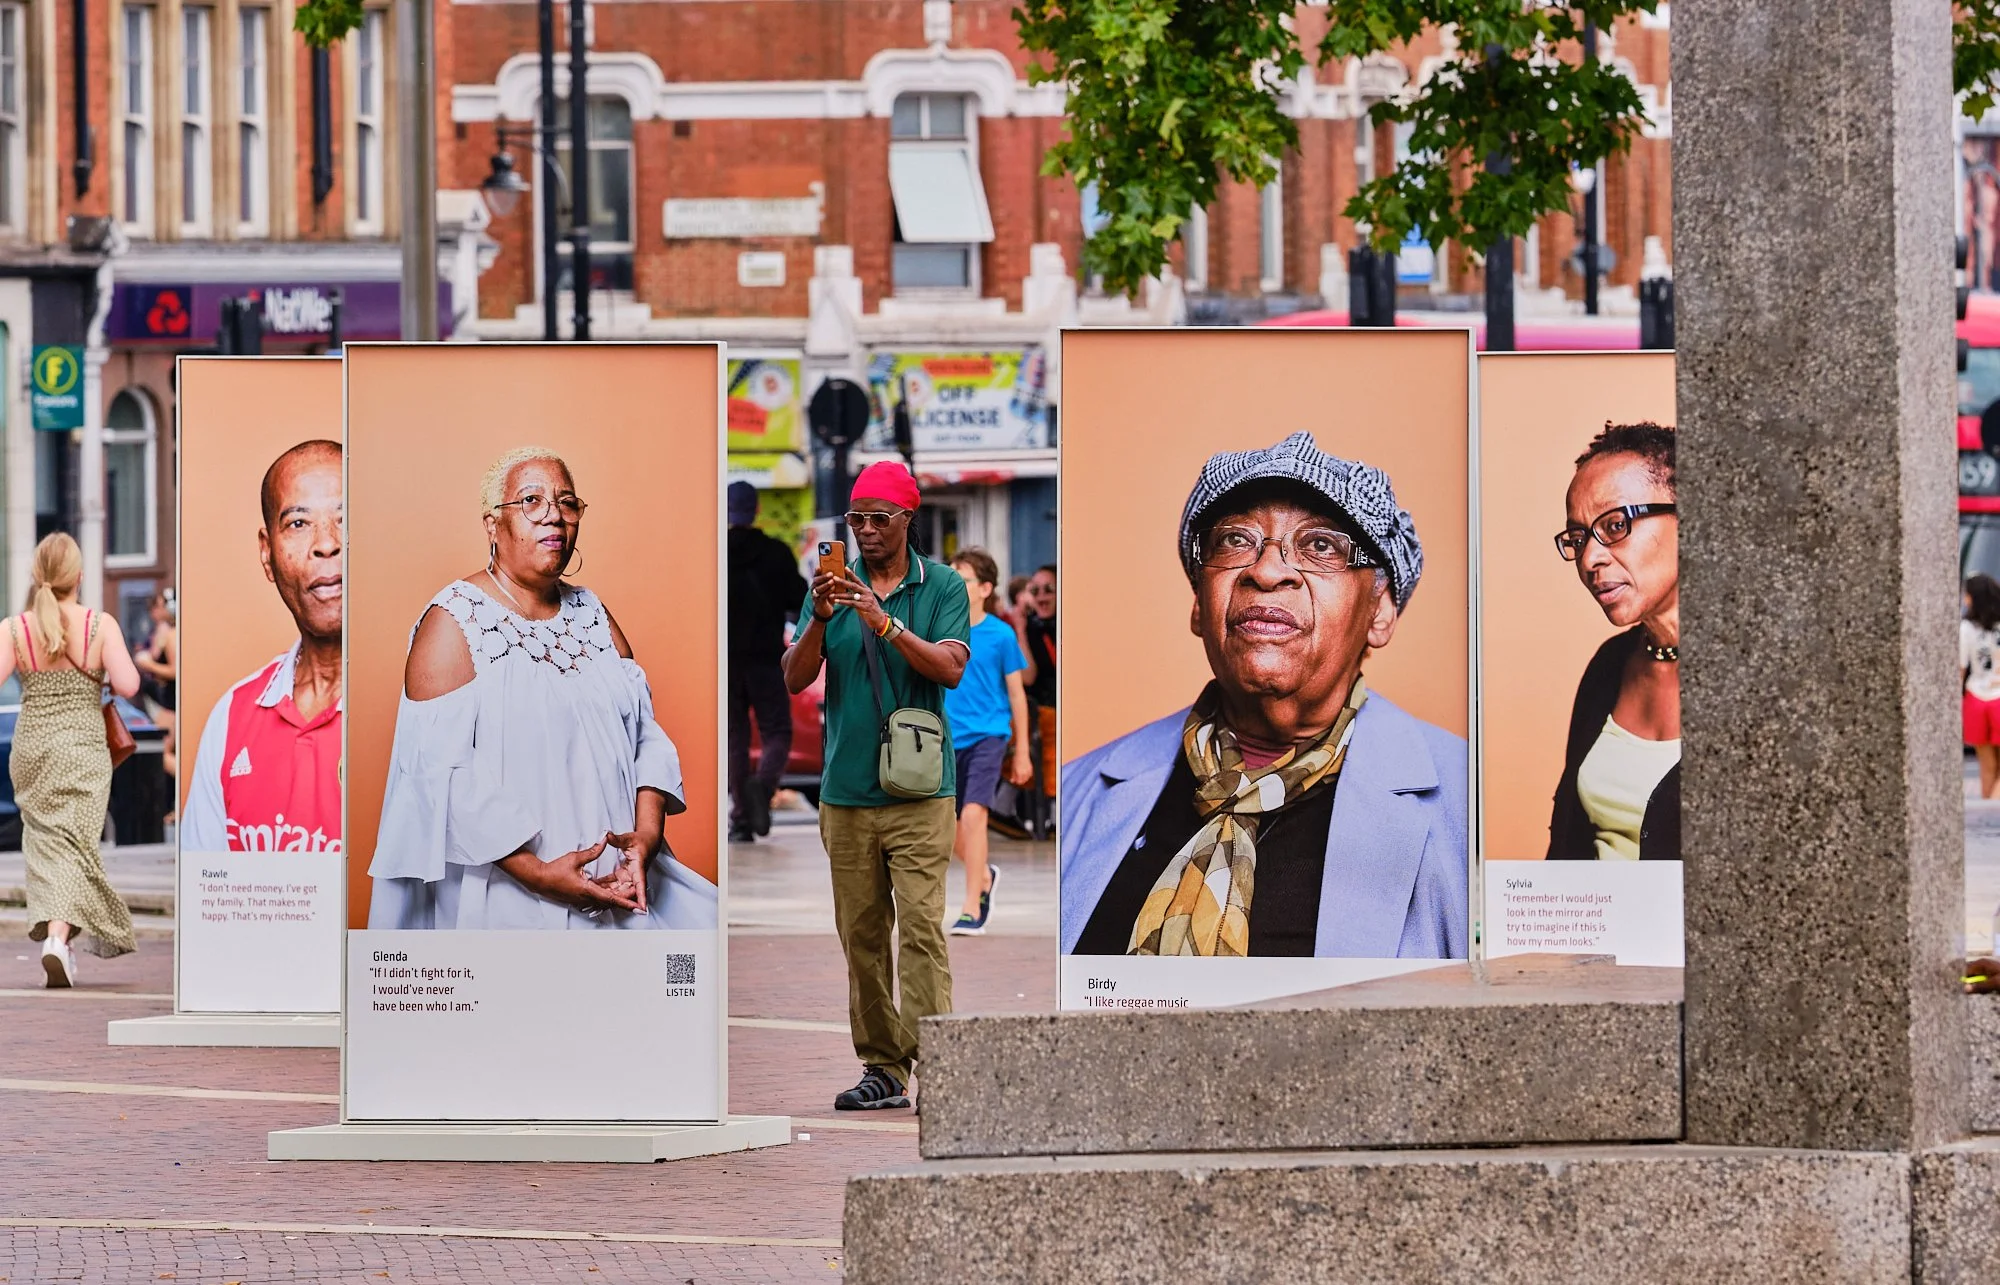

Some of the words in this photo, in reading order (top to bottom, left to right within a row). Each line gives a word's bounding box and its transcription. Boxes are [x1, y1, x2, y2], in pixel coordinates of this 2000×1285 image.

[911, 407, 1001, 429] LICENSE
[202, 870, 227, 878] Rawle
[1506, 879, 1532, 889] Sylvia
[208, 884, 228, 892] don't
[232, 884, 252, 892] need
[254, 886, 284, 894] money.
[287, 884, 301, 893] I've
[303, 885, 317, 895] got
[202, 900, 215, 908] my
[218, 898, 244, 908] family.
[248, 898, 266, 906] That
[269, 899, 295, 907] makes
[1513, 894, 1558, 902] remember
[1566, 894, 1593, 903] would
[1595, 894, 1611, 904] just
[202, 912, 229, 922] happy.
[232, 912, 257, 920] That's
[260, 914, 272, 922] my
[1507, 908, 1525, 917] look
[1528, 908, 1536, 917] in
[1539, 909, 1552, 917] the
[1556, 908, 1583, 917] mirror
[1586, 909, 1602, 917] and
[1507, 924, 1520, 932] try
[1534, 922, 1569, 934] imagine
[1572, 923, 1578, 931] if
[1581, 923, 1596, 931] this
[1599, 922, 1606, 932] is
[1507, 937, 1526, 945] how
[1529, 939, 1542, 947] my
[373, 951, 407, 961] Glenda
[370, 968, 381, 977] "If
[390, 968, 418, 978] didn't
[421, 968, 444, 980] fight
[447, 968, 461, 978] for
[464, 968, 474, 980] it,
[379, 984, 423, 994] would've
[1088, 978, 1116, 991] Birdy
[667, 988, 695, 996] LISTEN
[373, 1001, 396, 1011] have
[400, 1001, 423, 1011] been
[426, 1001, 447, 1011] who
[456, 1001, 478, 1011] am."
[1085, 996, 1091, 1006] "I
[1096, 996, 1113, 1007] like
[1117, 999, 1153, 1008] reggae
[1158, 997, 1188, 1008] music
